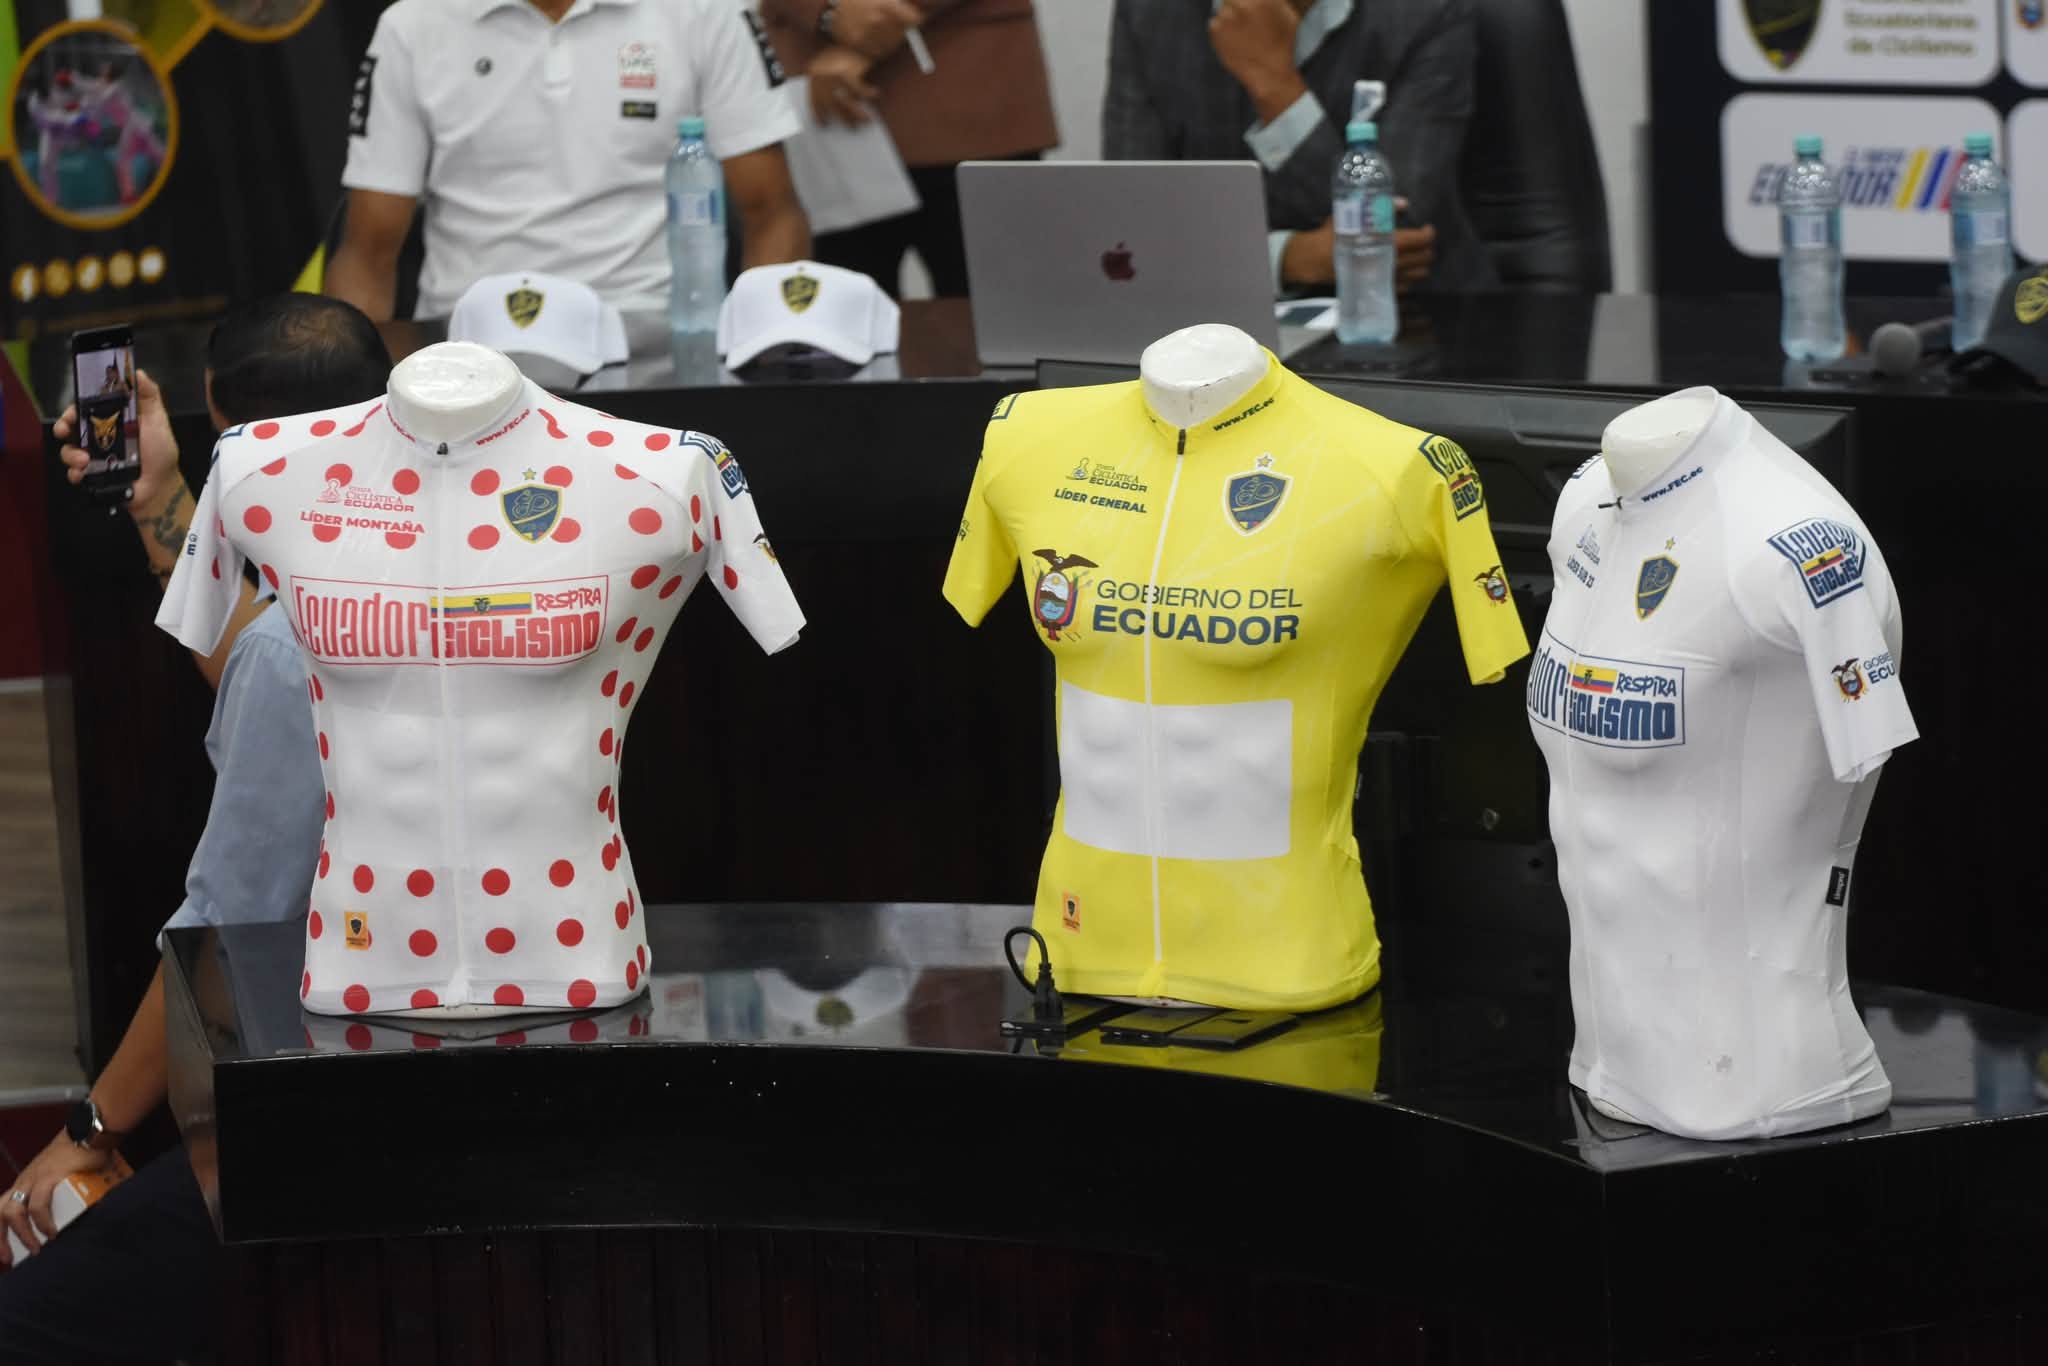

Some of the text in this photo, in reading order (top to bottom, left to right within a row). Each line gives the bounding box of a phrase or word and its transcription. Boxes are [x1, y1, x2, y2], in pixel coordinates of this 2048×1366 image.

[1089, 476, 1148, 493] ECUADOR
[343, 499, 415, 513] ECUADOR
[1054, 487, 1147, 514] LÍDER GENERAL
[300, 510, 425, 534] LÍDER MONTAÑA
[1097, 579, 1303, 610] GOBIERNO DEL
[1092, 604, 1300, 646] ECUADOR
